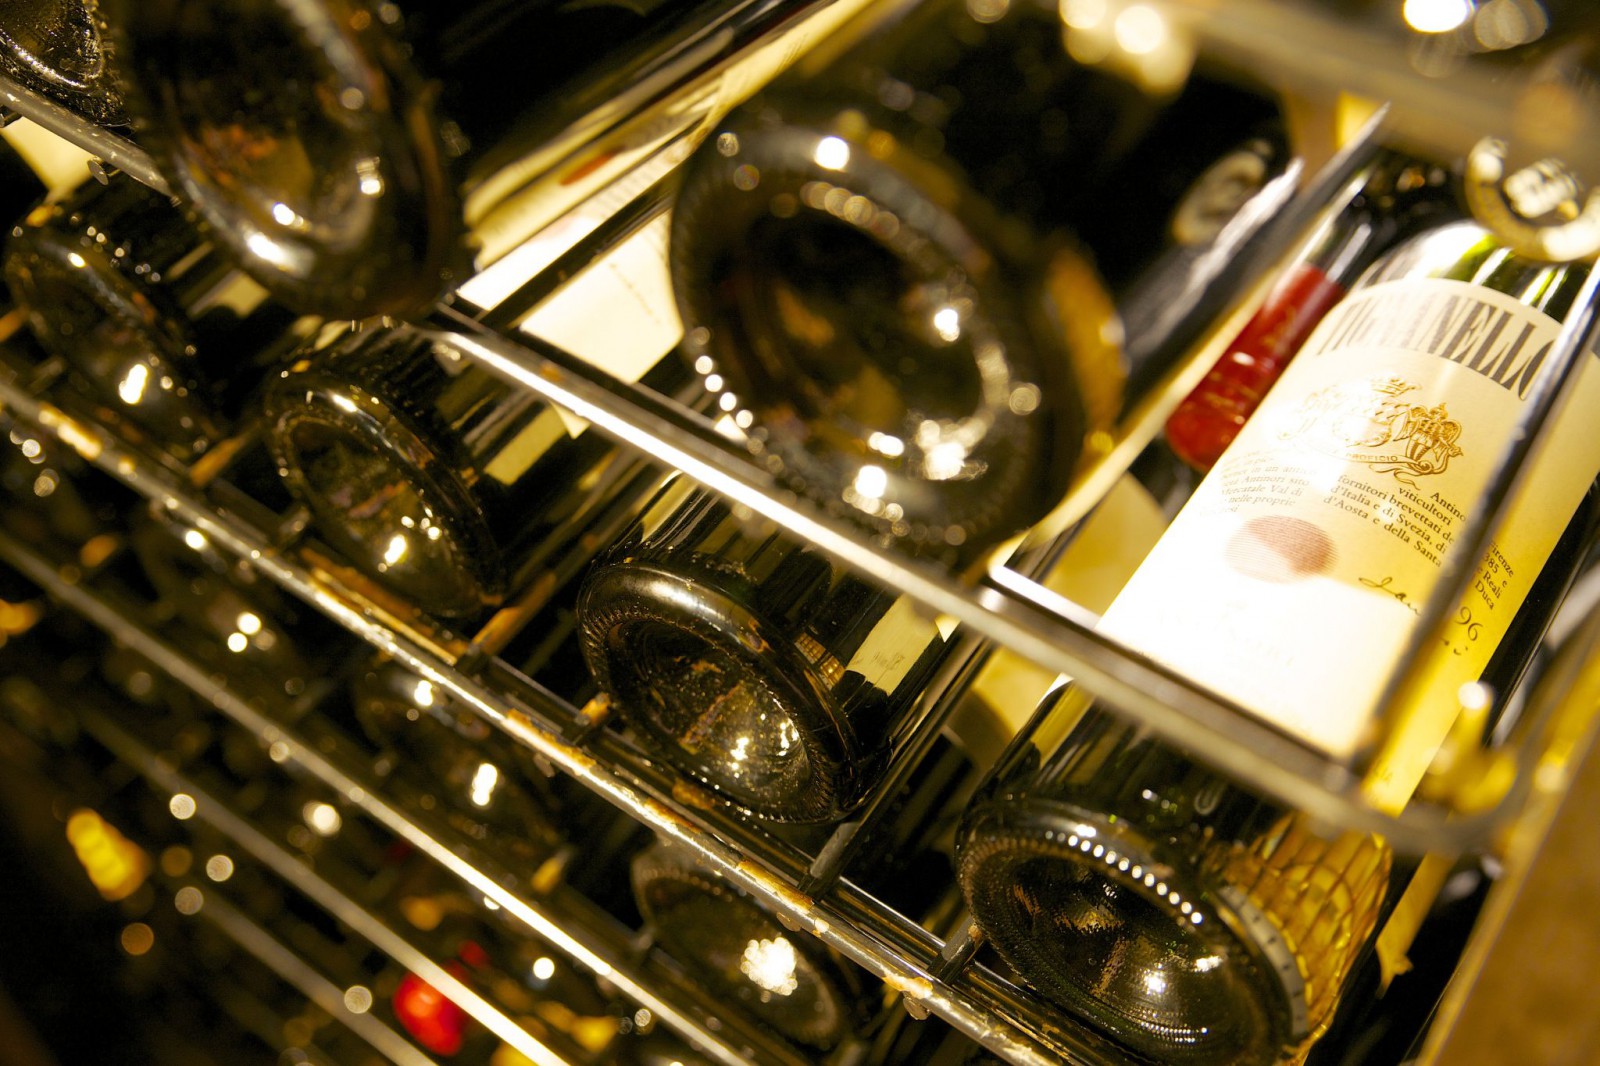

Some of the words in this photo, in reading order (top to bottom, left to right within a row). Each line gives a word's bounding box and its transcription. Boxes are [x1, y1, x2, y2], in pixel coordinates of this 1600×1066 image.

[1323, 495, 1370, 519] d'Aosta
[1384, 523, 1411, 543] della
[1413, 541, 1442, 567] Santa
[1337, 474, 1388, 500] fornitori
[1389, 495, 1443, 534] brevettati
[1399, 487, 1453, 526] viticultori
[1430, 492, 1466, 523] Antino
[1490, 541, 1514, 578] irenze
[1382, 507, 1395, 518] di
[1396, 513, 1433, 546] Svezia,
[1475, 580, 1495, 610] Duca
